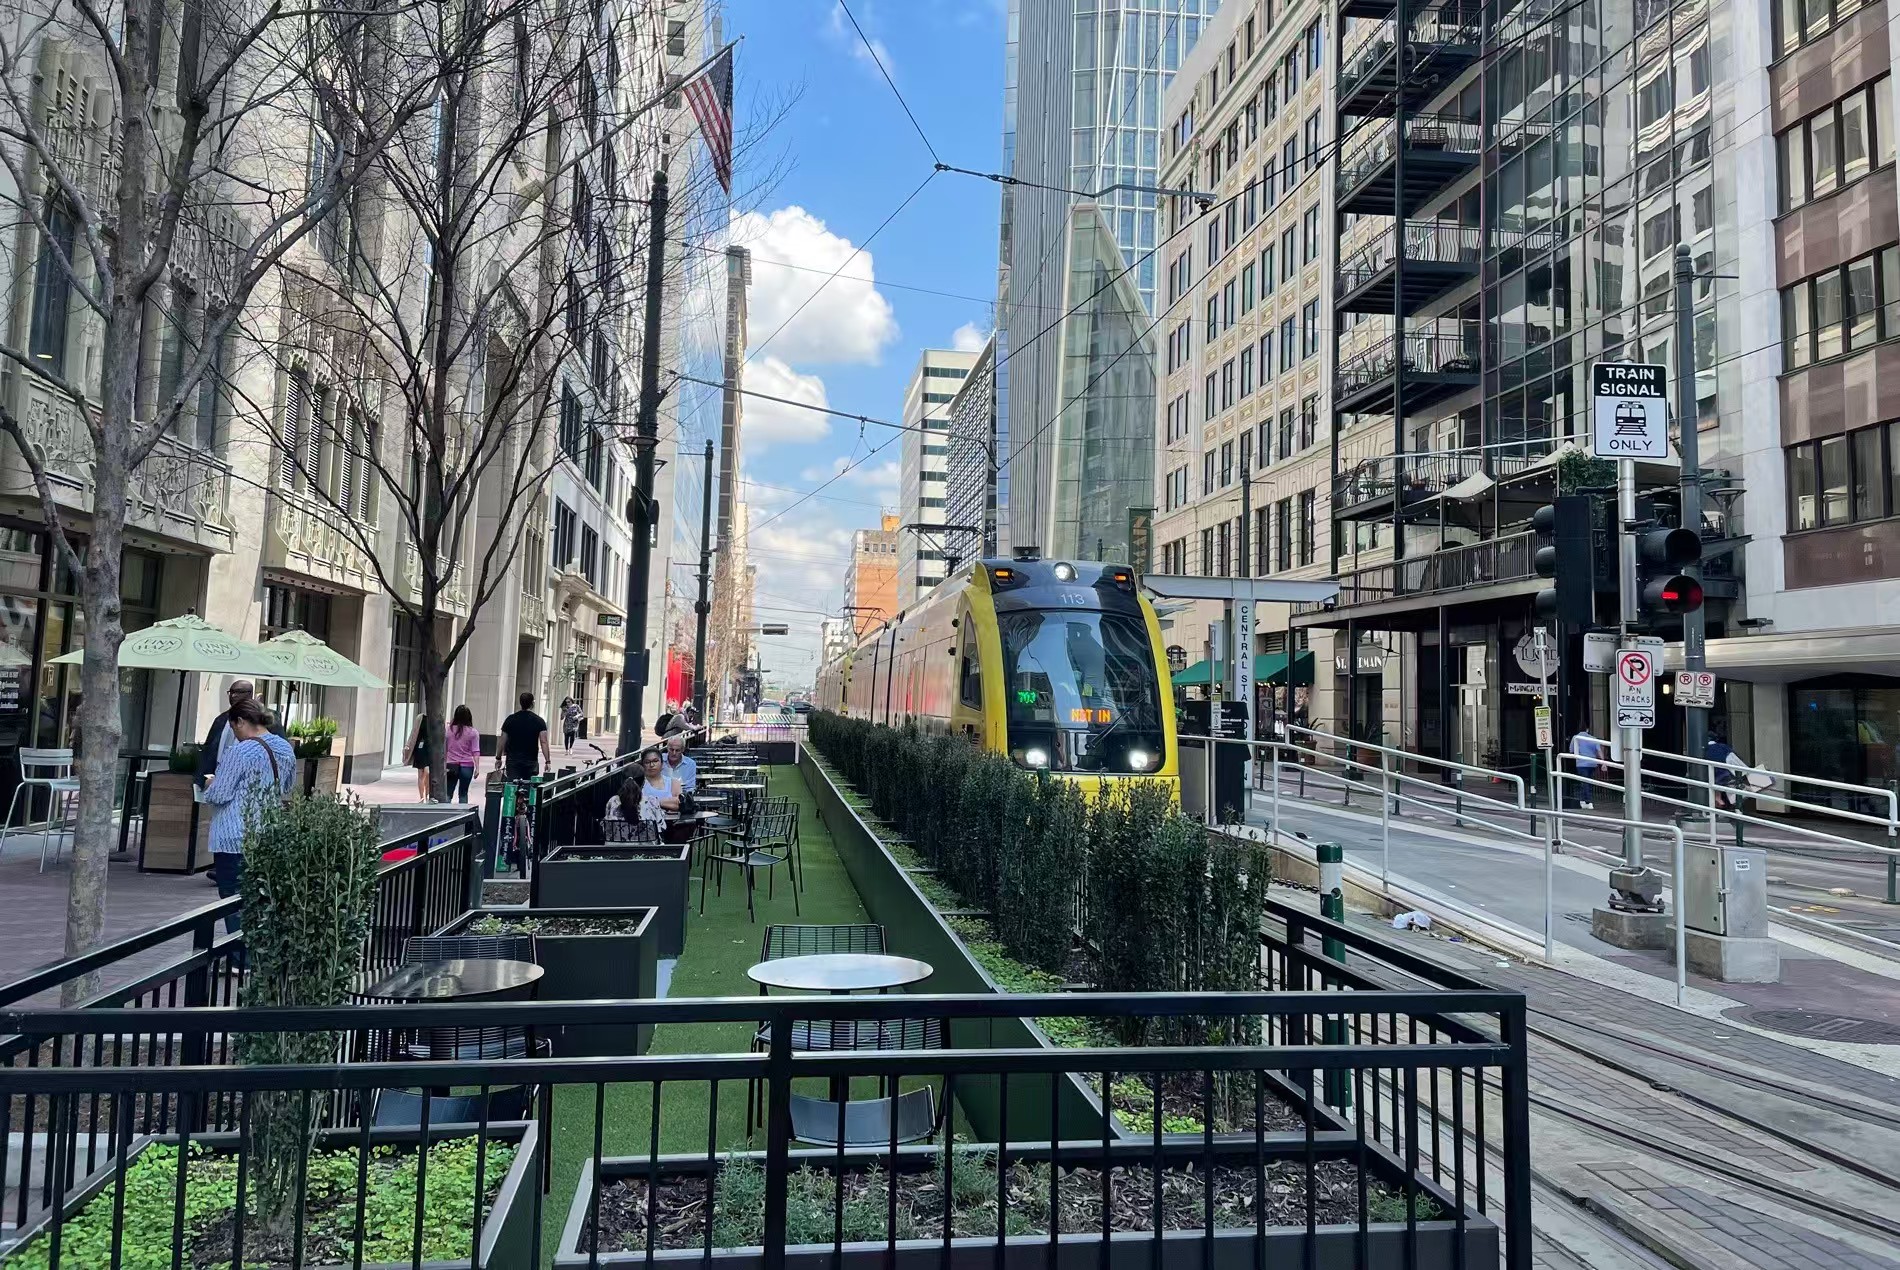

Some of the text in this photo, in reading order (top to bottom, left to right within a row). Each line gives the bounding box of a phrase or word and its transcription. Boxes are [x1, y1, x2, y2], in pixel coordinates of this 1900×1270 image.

[1606, 368, 1654, 380] TRAIN
[1600, 383, 1660, 396] SIGNAL
[1609, 439, 1652, 451] ONLY
[1060, 594, 1085, 605] 113
[1241, 605, 1249, 669] CENTRAL
[1621, 695, 1651, 704] TRACKS
[1071, 708, 1111, 722] NOT IN
